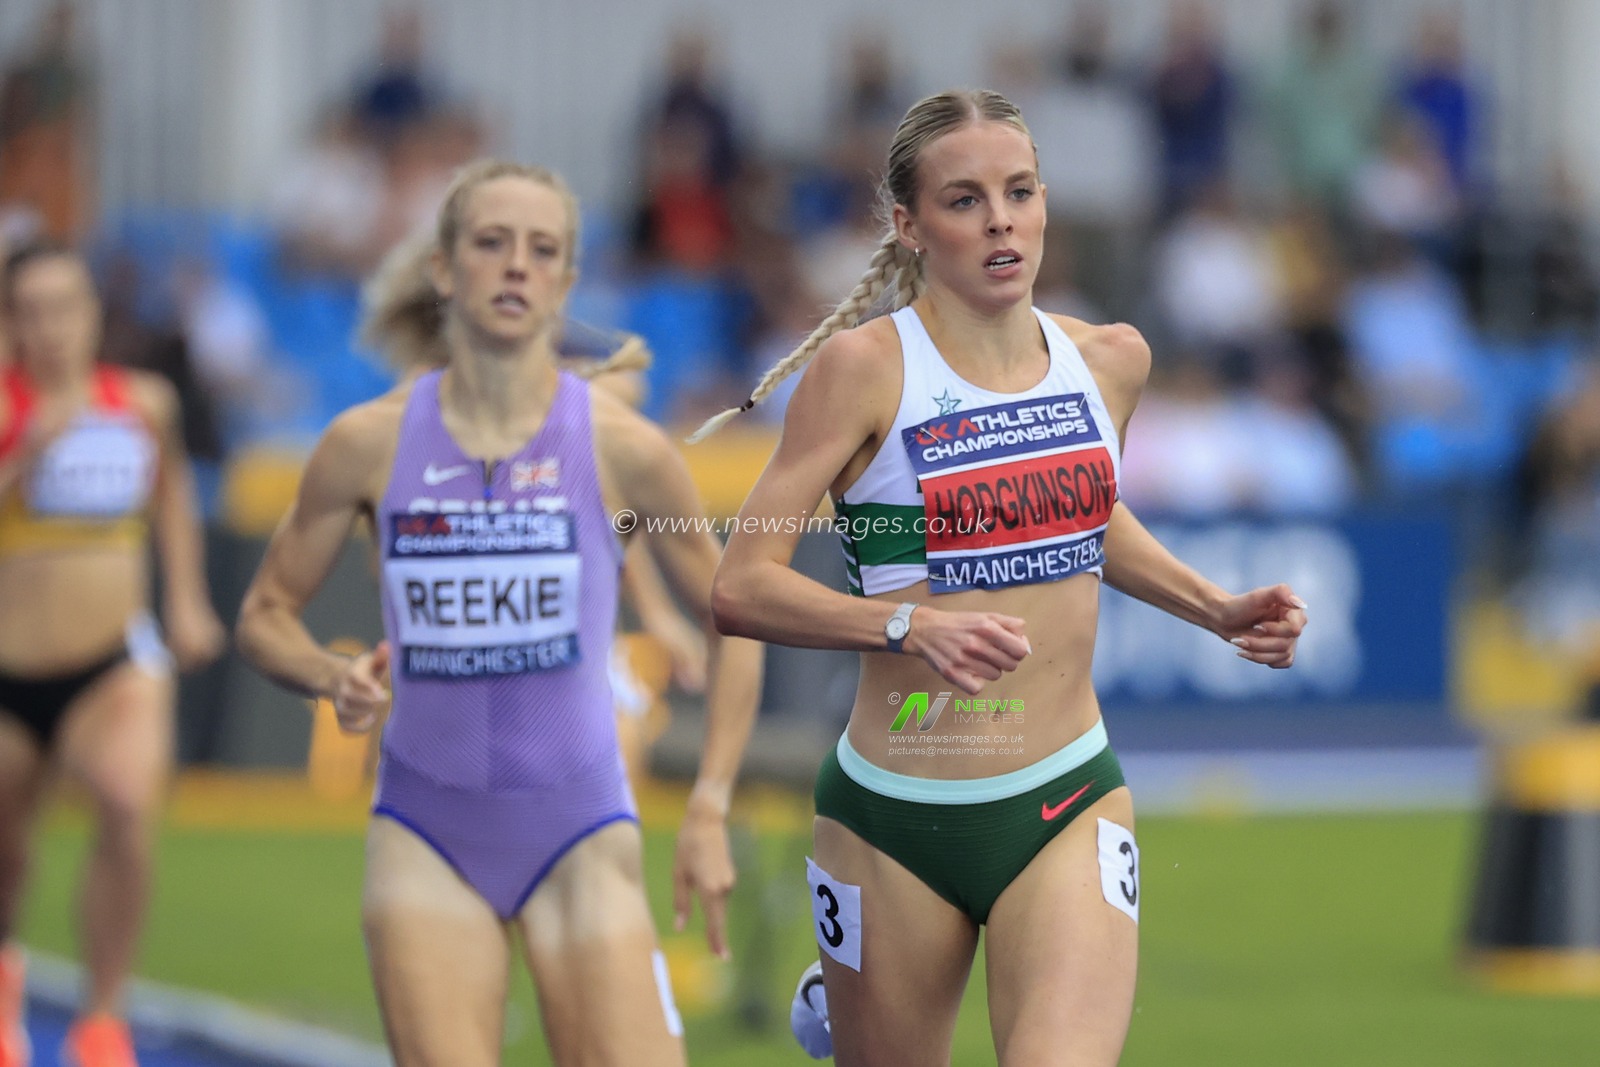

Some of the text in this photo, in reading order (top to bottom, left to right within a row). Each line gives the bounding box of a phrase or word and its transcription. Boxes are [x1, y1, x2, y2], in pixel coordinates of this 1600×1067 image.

[922, 418, 1089, 463] CHAMPIONSHIPS
[957, 400, 1083, 437] ATHLETICS
[934, 460, 1110, 539] HODGKINSON
[945, 537, 1100, 586] MANCHESTER
[405, 576, 561, 626] REEKIE
[408, 637, 571, 676] MANCHESTER
[1119, 841, 1137, 907] 3
[816, 884, 844, 948] 3
